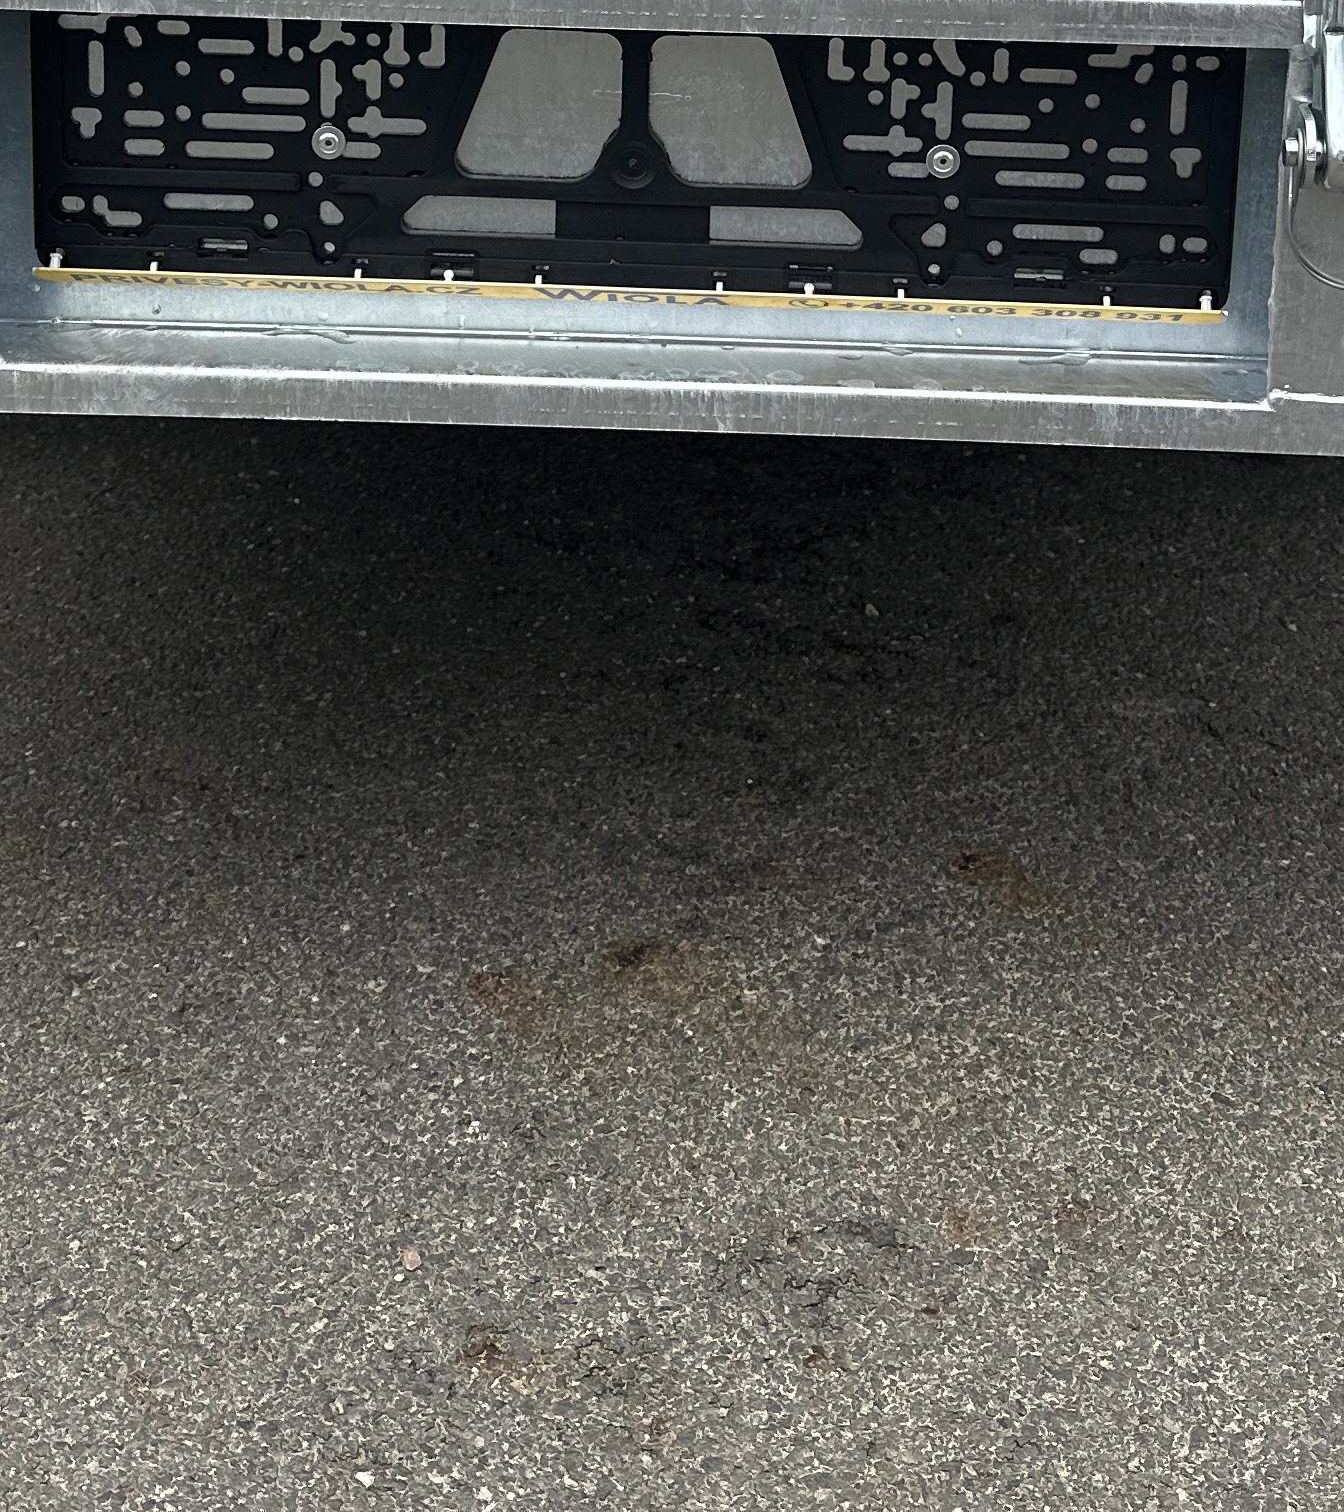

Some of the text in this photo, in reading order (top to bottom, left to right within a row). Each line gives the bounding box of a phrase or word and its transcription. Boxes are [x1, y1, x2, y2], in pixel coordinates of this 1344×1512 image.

[70, 273, 484, 296] PRIVESY-WIOLA.CZ
[532, 287, 730, 306] WIOLA
[839, 299, 1185, 322] +420 603 308 931
